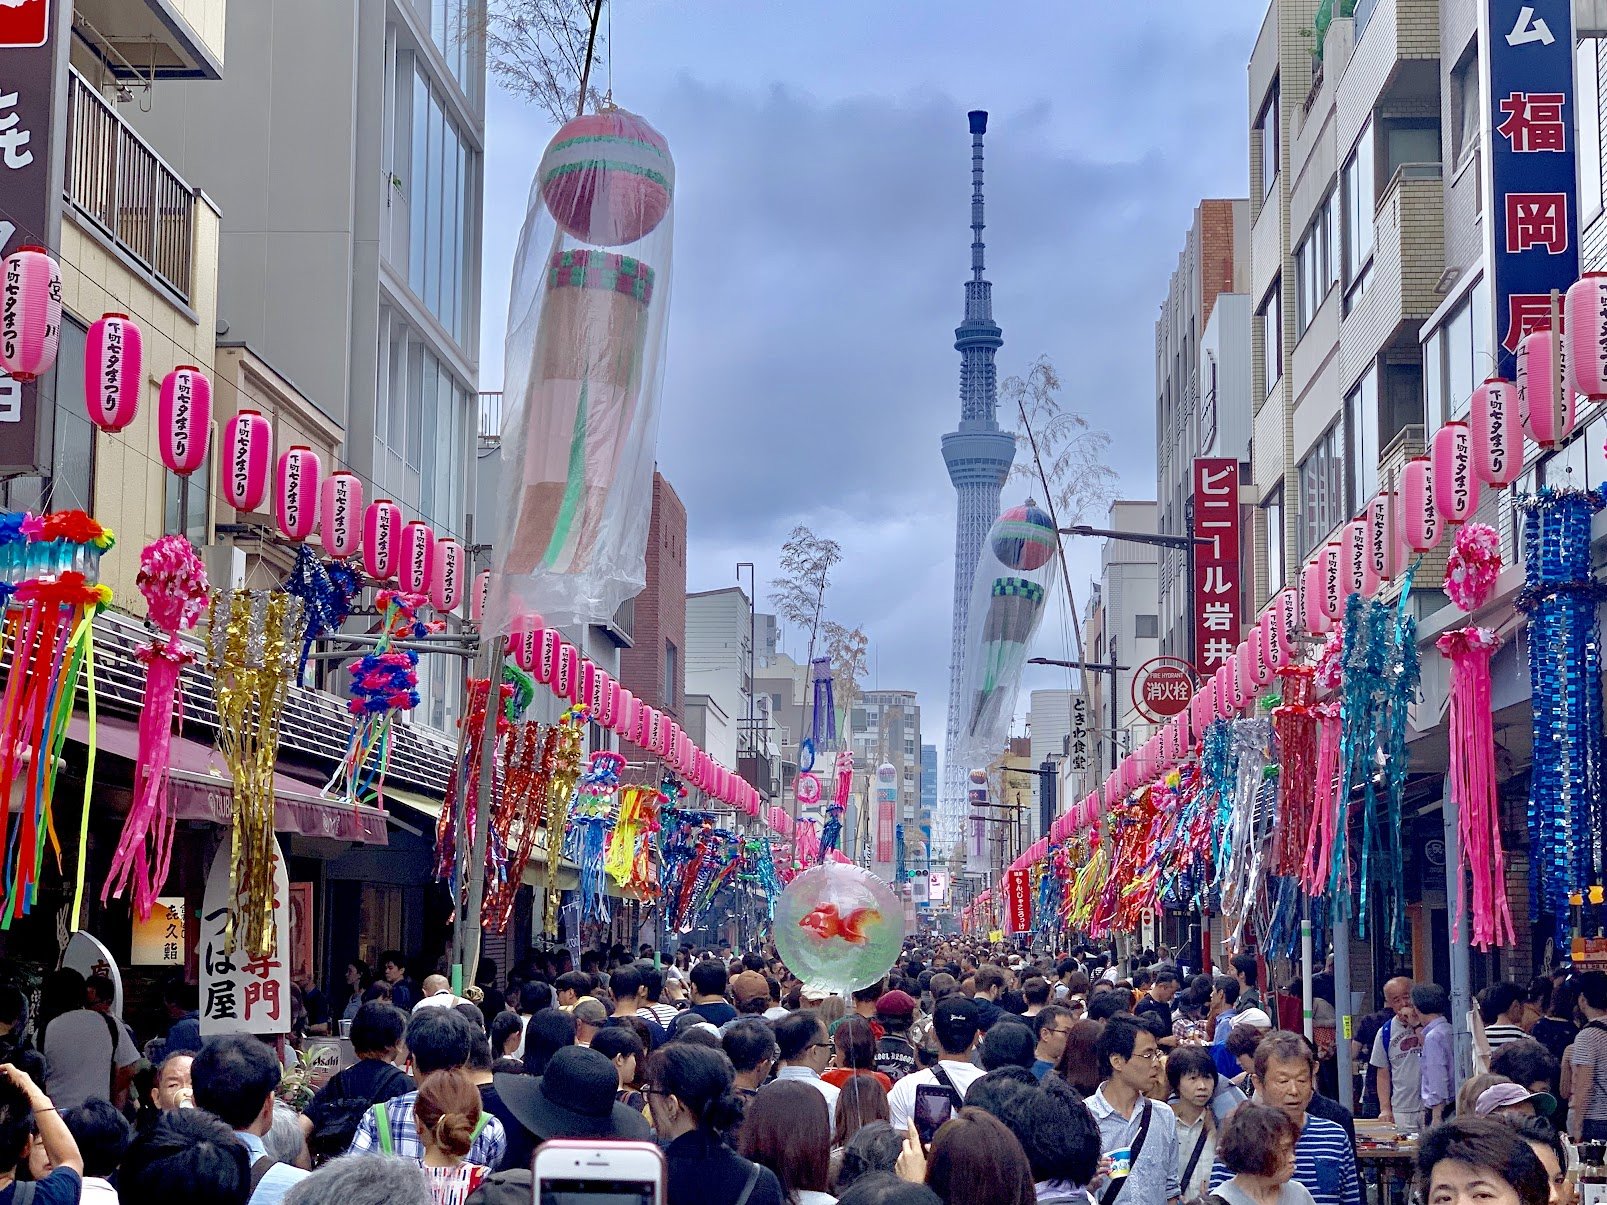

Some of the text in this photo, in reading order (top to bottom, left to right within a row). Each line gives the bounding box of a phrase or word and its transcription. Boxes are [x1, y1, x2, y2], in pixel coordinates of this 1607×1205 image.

[3, 257, 21, 358] 下町七夕まつり
[104, 322, 122, 412] 下町七夕まつり
[174, 374, 191, 457] 下町七夕まつり
[1489, 389, 1505, 473] 下町七夕まつり
[235, 418, 250, 497] 下町七夕まつり
[287, 454, 301, 527] 下町七夕まつり
[1454, 433, 1467, 512] 下町七夕まつり
[334, 480, 348, 549] 下町七夕まつり
[377, 507, 391, 571] 下町七夕まつり
[1373, 503, 1385, 572] 下町七夕まつり
[413, 528, 426, 588] 下町七夕まつり
[444, 546, 456, 605] 下町七夕まつり
[1201, 465, 1235, 666] ビニール岩井
[1327, 551, 1338, 614] 下町七夕まつり
[1353, 527, 1364, 590] 下町七夕まつり
[1146, 681, 1189, 701] 消火栓
[1072, 698, 1087, 770] ときわ食堂
[313, 1055, 339, 1067] Asahi
